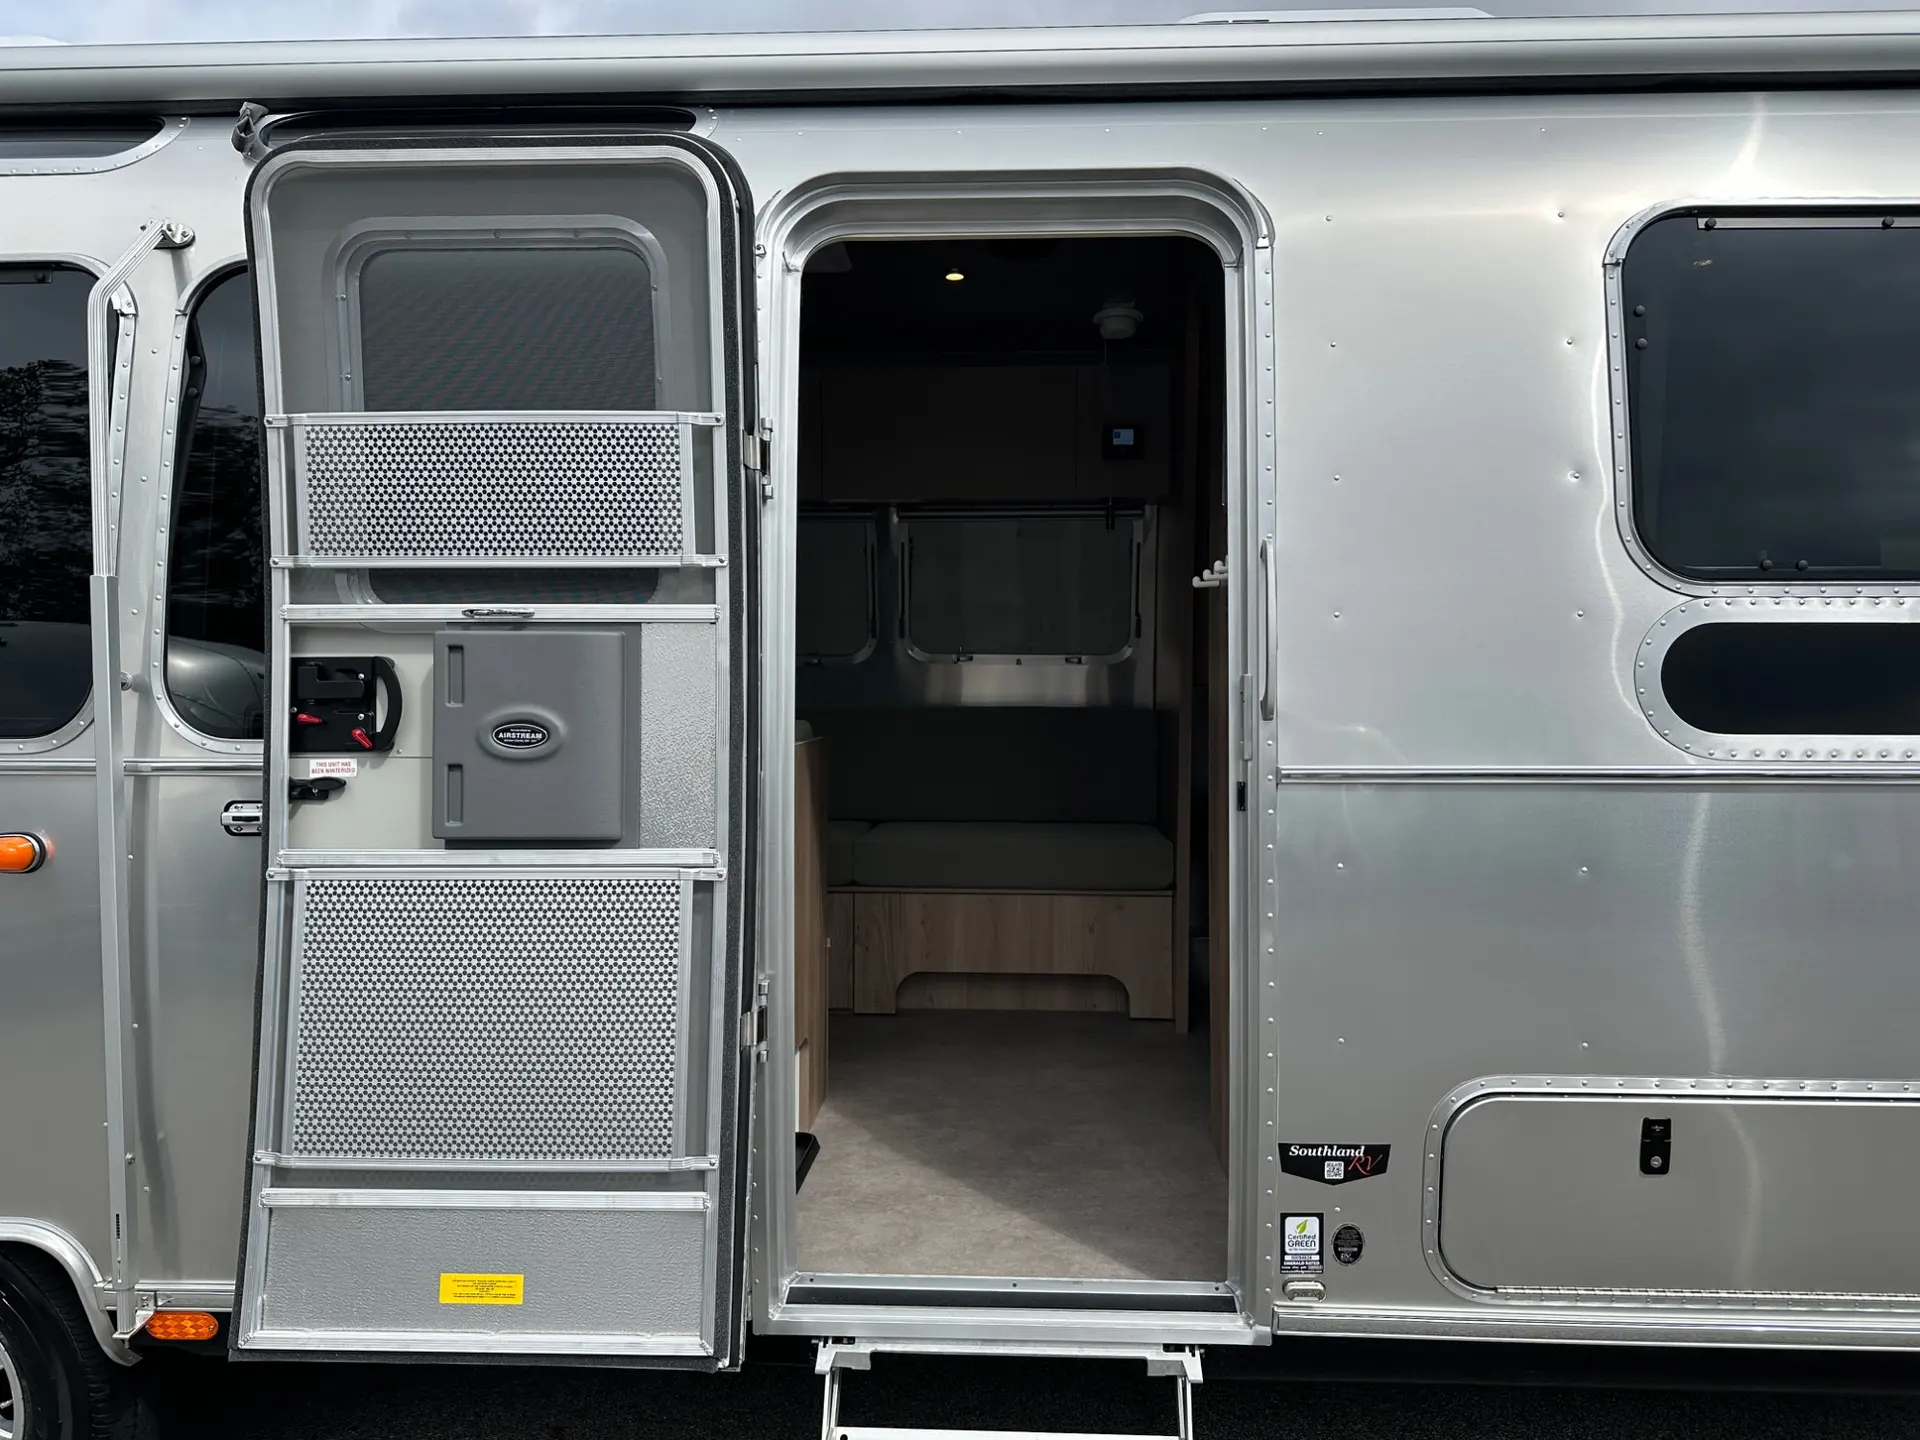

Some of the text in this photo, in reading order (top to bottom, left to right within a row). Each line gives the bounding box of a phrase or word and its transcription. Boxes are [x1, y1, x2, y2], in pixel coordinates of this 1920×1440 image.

[1289, 1144, 1365, 1157] Southland
[1347, 1154, 1383, 1176] RV
[1287, 1240, 1316, 1248] GREEN
